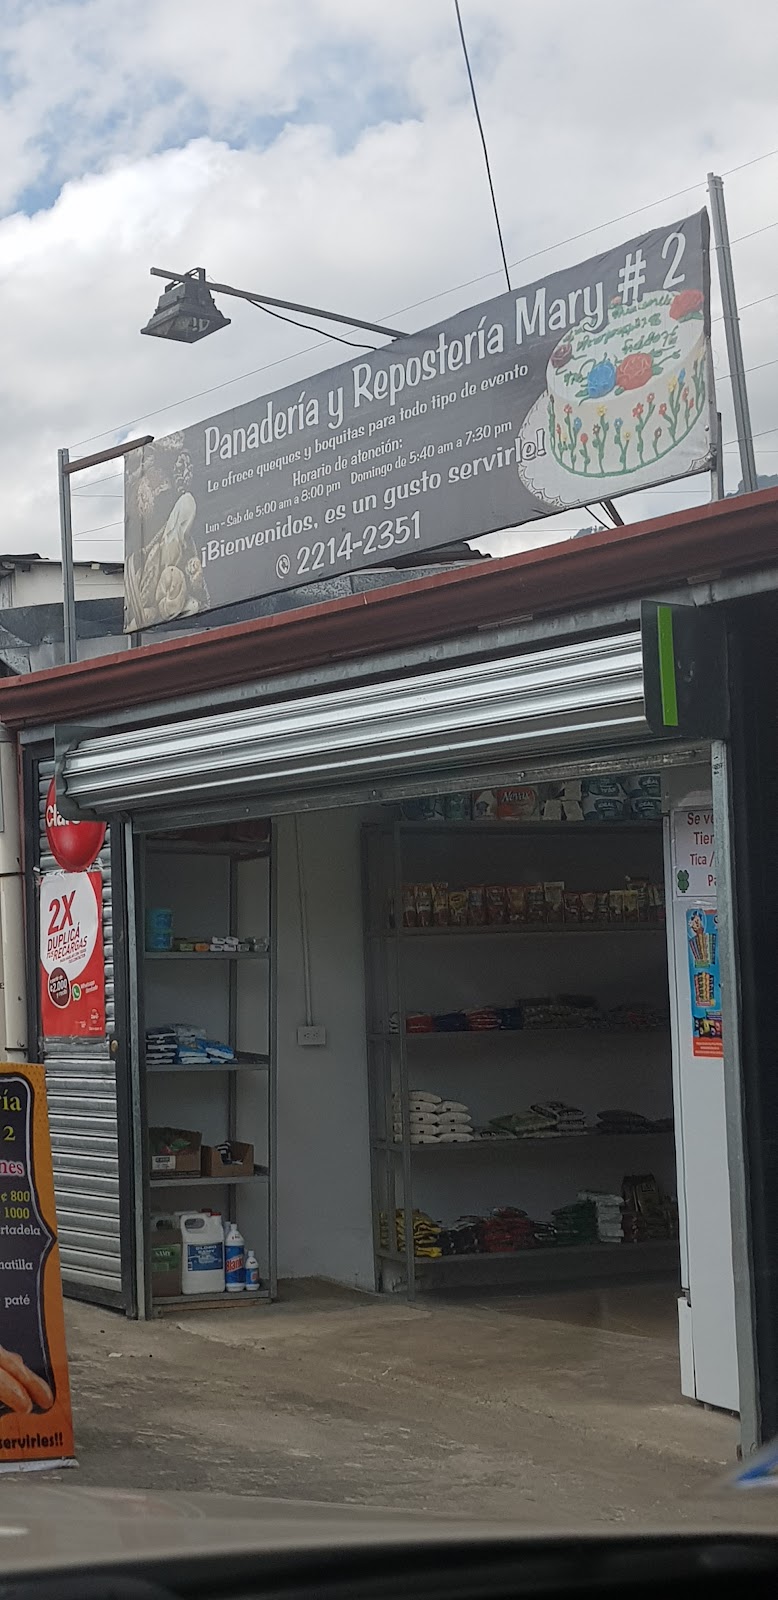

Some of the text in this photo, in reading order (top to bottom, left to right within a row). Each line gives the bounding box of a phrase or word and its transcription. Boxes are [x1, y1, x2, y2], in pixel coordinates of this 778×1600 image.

[204, 232, 687, 466] Panadería y Repostería Mary # 2
[207, 363, 529, 493] Le ofrece queques y boquitas para todo tipo de evento
[292, 437, 404, 487] Horario de atención:
[205, 523, 219, 534] Lun
[226, 512, 242, 527] Sab
[243, 509, 254, 521] de
[255, 501, 277, 517] 5:00
[278, 498, 292, 510] am
[294, 495, 300, 505] a
[301, 486, 324, 502] 8:00
[326, 481, 341, 496] pm
[350, 461, 393, 485] Domingo
[395, 457, 407, 469] de
[409, 445, 435, 465] 5:40
[437, 440, 454, 455] am
[456, 437, 463, 449] a
[465, 424, 491, 446] 7:30
[494, 419, 513, 440] pm
[201, 428, 547, 568] ¡Bienvenidos, es un gusto servirle!
[296, 510, 422, 575] 2214-2351
[46, 804, 81, 828] Cla
[687, 812, 701, 826] Se
[690, 853, 707, 866] Tica
[48, 890, 76, 936] 2X
[47, 921, 80, 952] DUPLICÁ
[53, 936, 88, 961] RECARGAS
[0, 1089, 22, 1111] ía
[3, 1126, 16, 1141] 2
[10, 1190, 30, 1202] 800
[4, 1207, 30, 1218] 1000
[4, 1294, 30, 1308] paté
